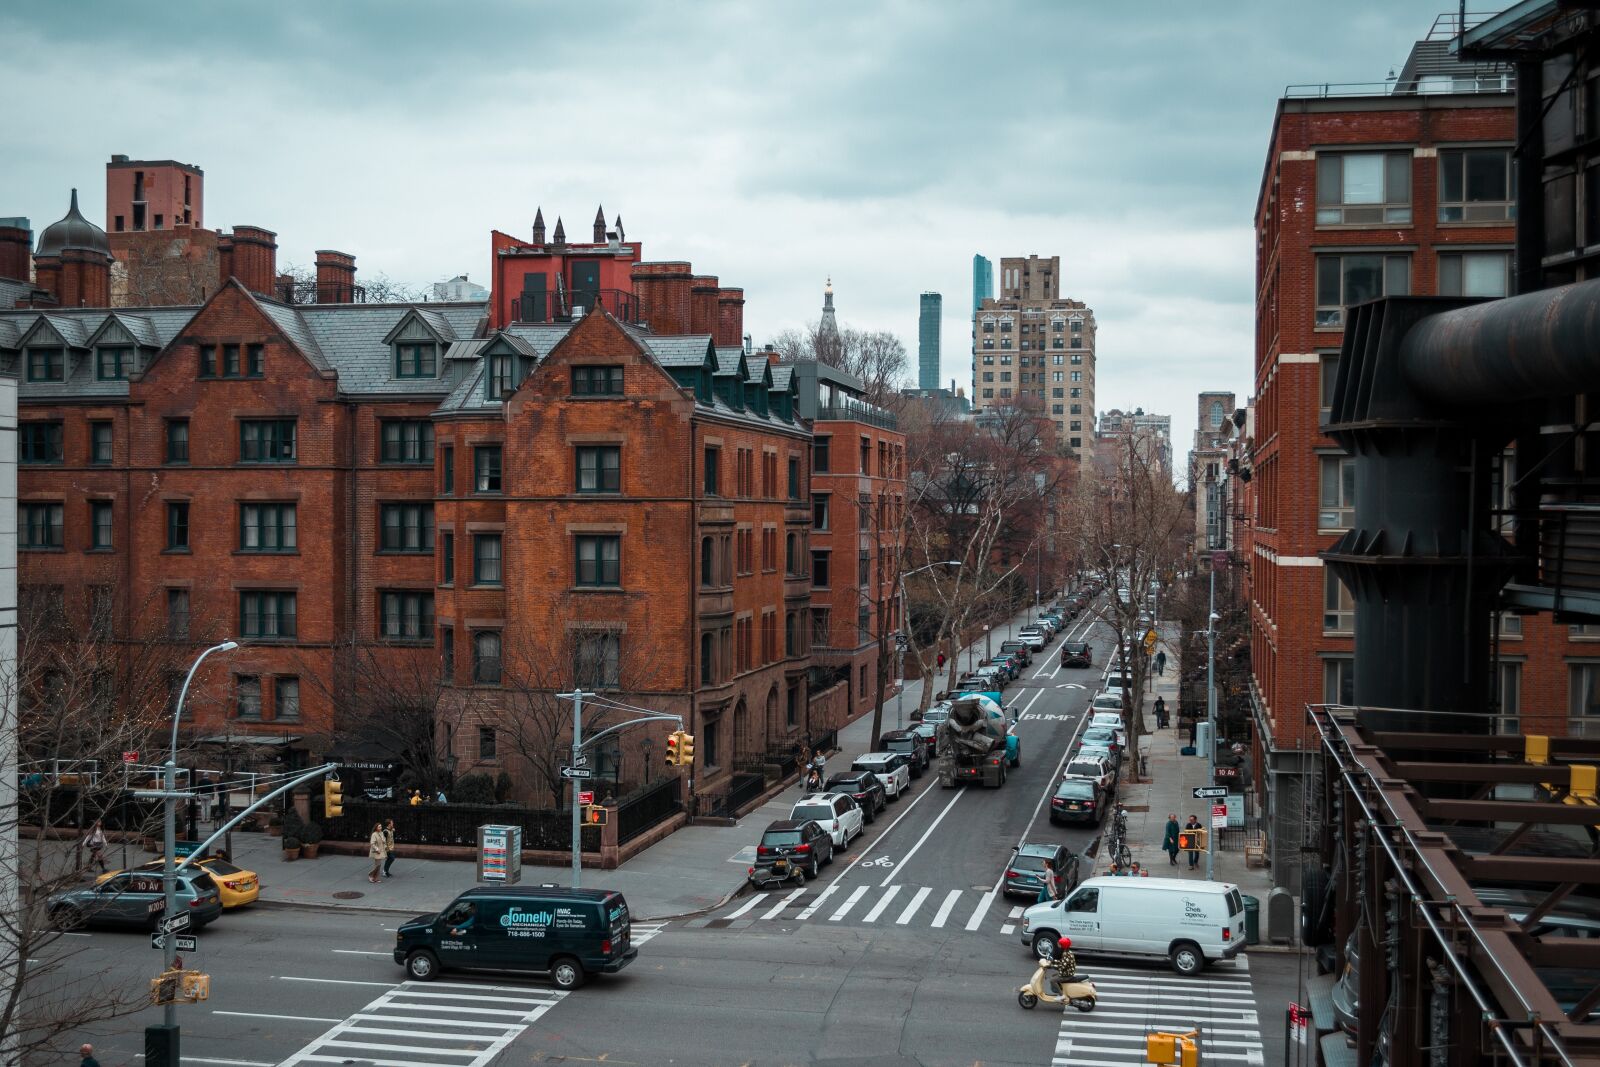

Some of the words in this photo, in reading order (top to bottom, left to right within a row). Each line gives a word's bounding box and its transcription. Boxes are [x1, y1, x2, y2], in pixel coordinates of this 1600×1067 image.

[1023, 713, 1076, 721] BUMP
[138, 881, 147, 890] 10
[149, 881, 159, 890] Av
[500, 907, 552, 926] donnelly
